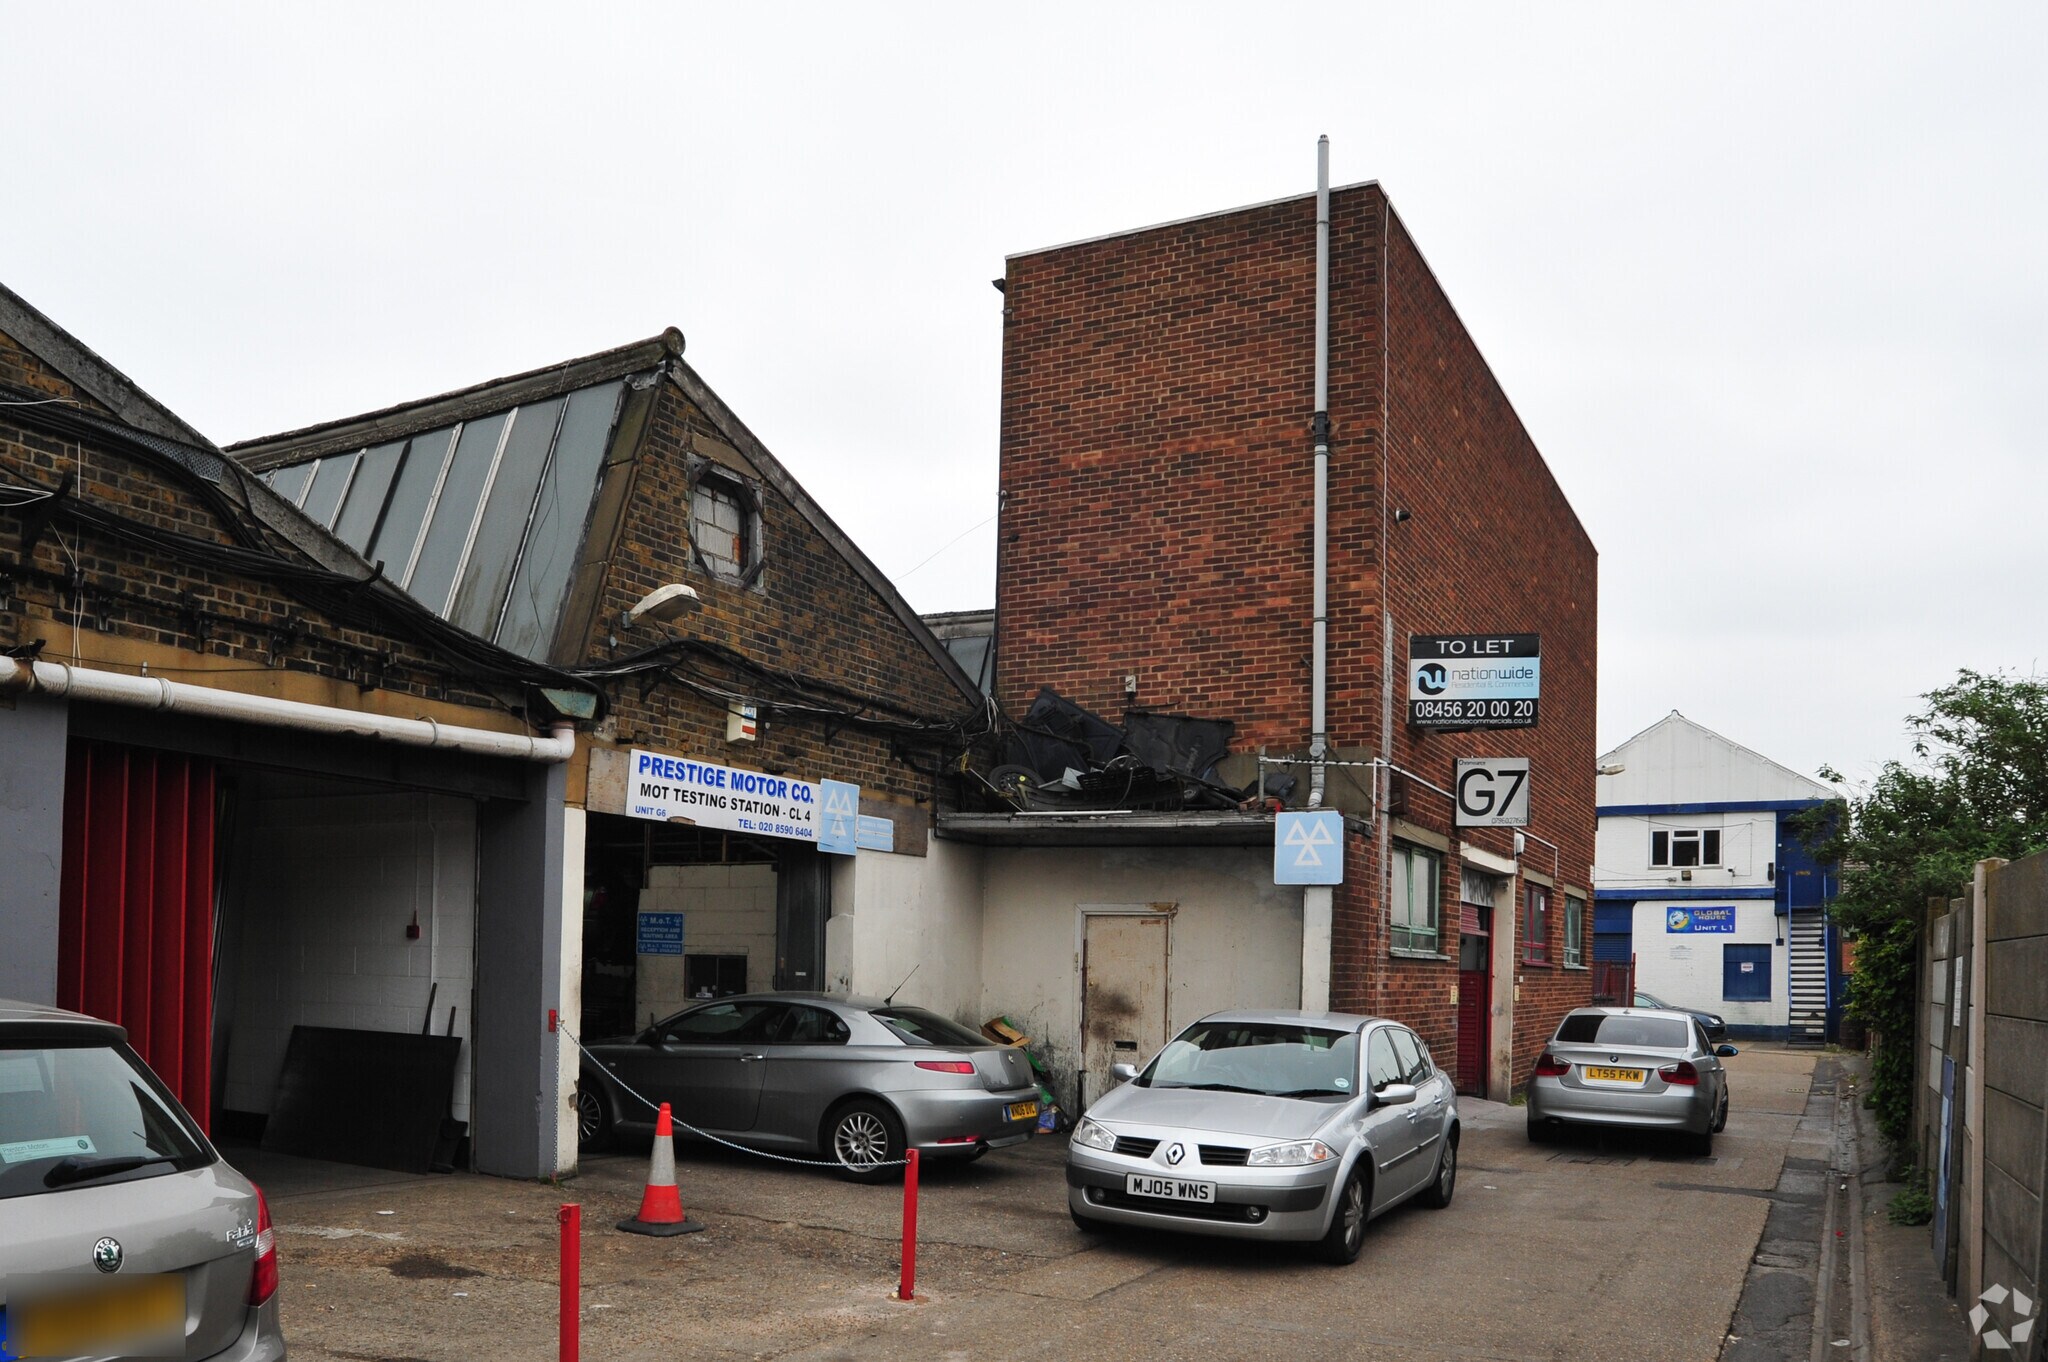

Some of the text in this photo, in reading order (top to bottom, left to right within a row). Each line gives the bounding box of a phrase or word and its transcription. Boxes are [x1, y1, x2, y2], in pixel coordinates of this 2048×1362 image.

[1436, 639, 1515, 654] TO LET
[1451, 666, 1533, 681] nationwide
[1451, 681, 1486, 689] Residential
[1494, 680, 1534, 688] Commercial
[1415, 700, 1534, 717] 08456 20 00 20
[1416, 717, 1532, 726] www.nationwidecommercials.co.uk
[638, 755, 814, 804] PRESTIGE MOTOR CO.
[1458, 768, 1527, 816] G7
[639, 782, 669, 800] MOT
[674, 788, 727, 809] TESTING
[730, 798, 780, 818] STATION
[789, 807, 801, 820] CL
[804, 810, 811, 822] 4
[635, 805, 667, 818] UNIT G6
[738, 818, 813, 837] TEL: 020 8590 6404
[1589, 1068, 1640, 1081] LT55 FKW
[1133, 1177, 1209, 1201] MJ05 WNS
[226, 1224, 254, 1243] Fabia
